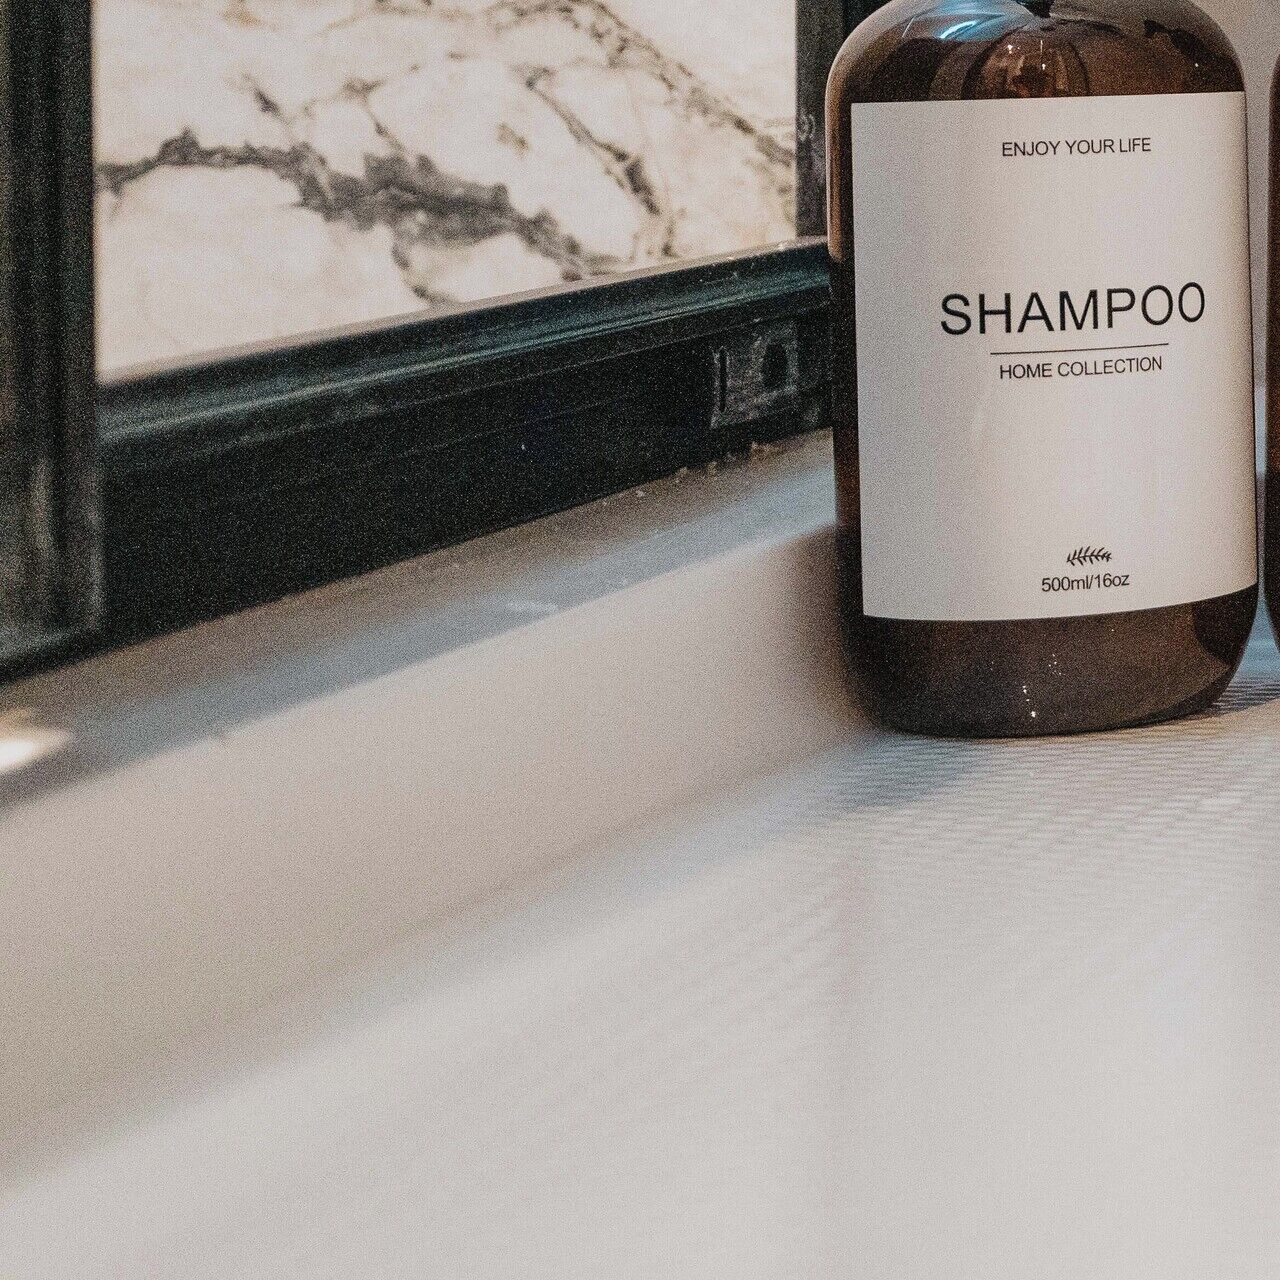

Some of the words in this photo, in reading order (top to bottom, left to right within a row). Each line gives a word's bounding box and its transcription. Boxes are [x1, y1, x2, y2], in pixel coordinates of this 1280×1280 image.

[1002, 141, 1060, 157] ENJOY
[1065, 139, 1115, 154] YOUR
[1120, 138, 1151, 152] LIFE
[941, 282, 1205, 336] SHAMPOO
[1000, 363, 1052, 379] HOME
[1058, 356, 1162, 377] COLLECTION
[1042, 573, 1129, 592] 500ml/16oz
